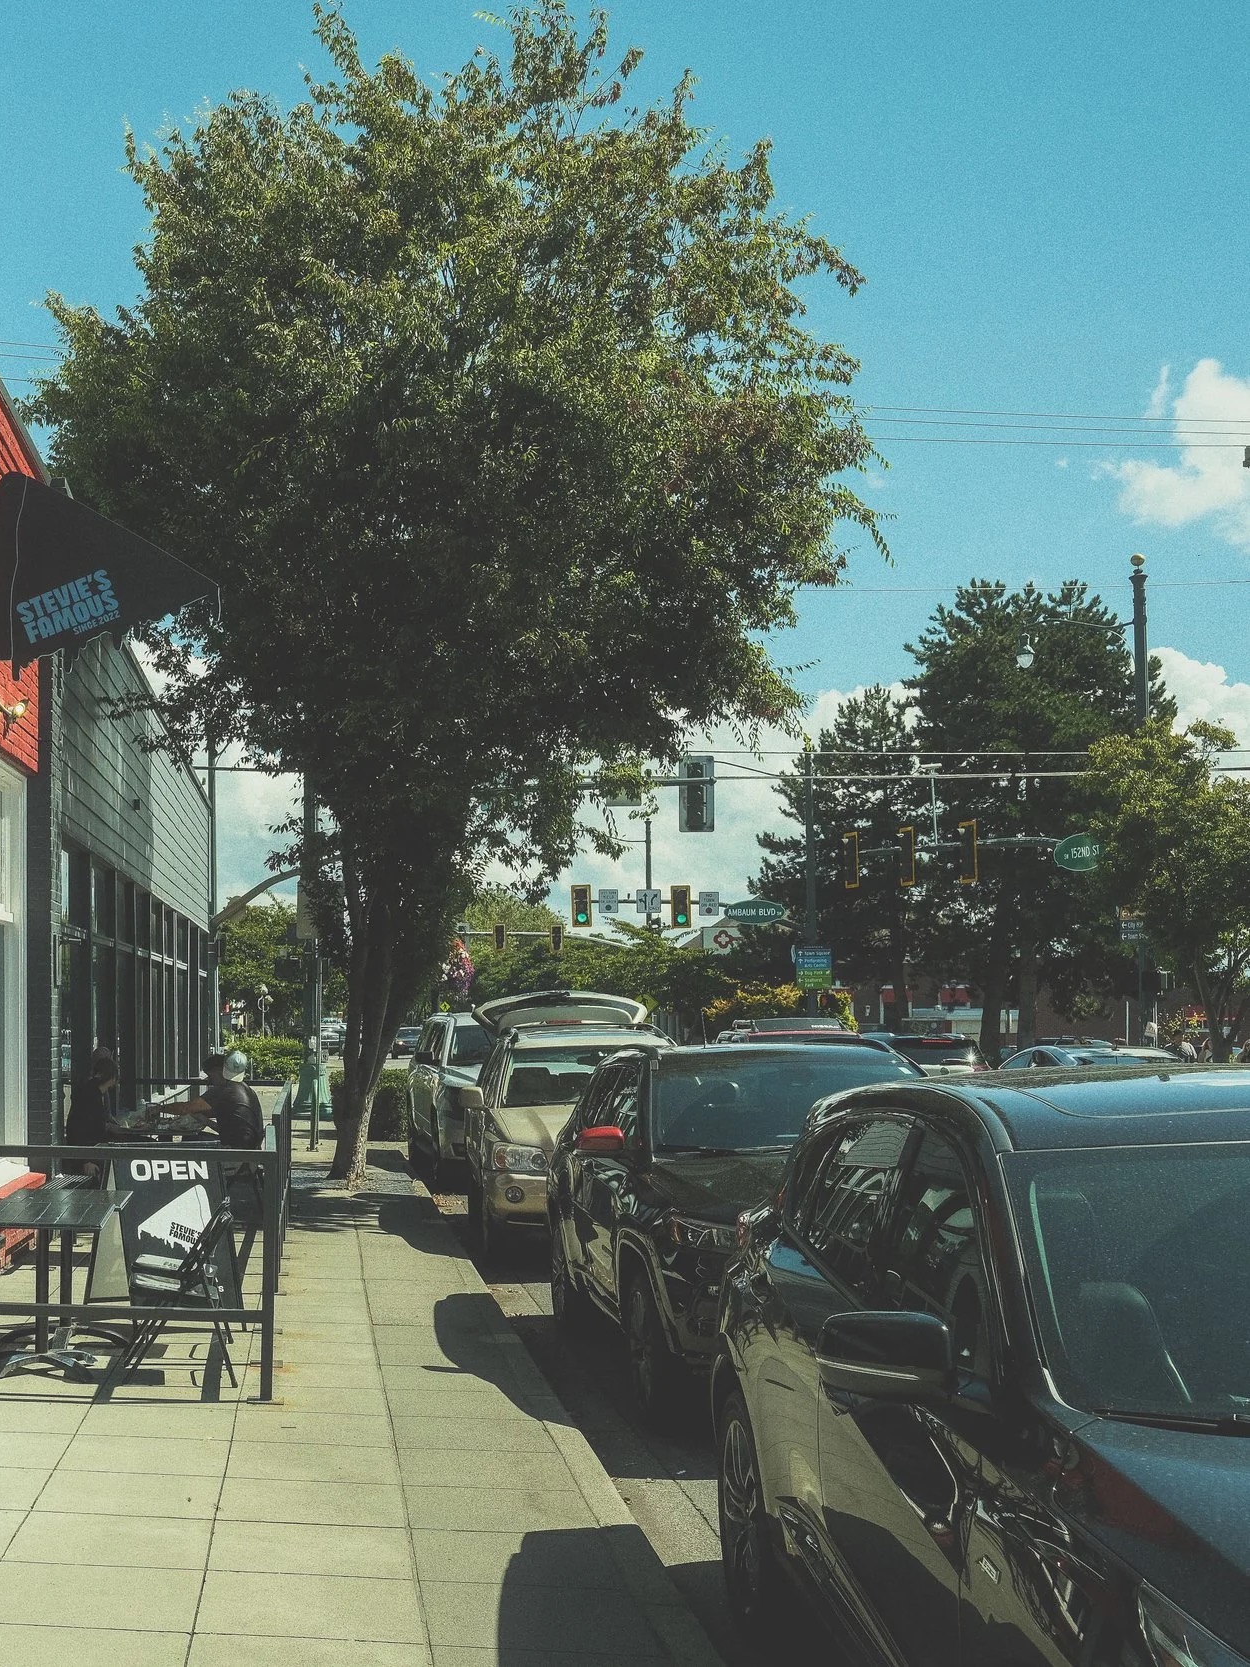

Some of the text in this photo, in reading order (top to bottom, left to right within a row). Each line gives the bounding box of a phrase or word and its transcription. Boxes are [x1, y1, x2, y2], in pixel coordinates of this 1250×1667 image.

[16, 569, 112, 623] STEVIE'S
[24, 590, 119, 644] FAMOUS
[72, 610, 120, 635] SINCE 2022
[1071, 846, 1090, 859] 152ND
[1092, 845, 1100, 856] ST
[758, 908, 776, 916] BLVD
[130, 1159, 209, 1181] OPEN
[168, 1229, 199, 1245] FAMOU
[170, 1221, 202, 1239] STEVIE'S
